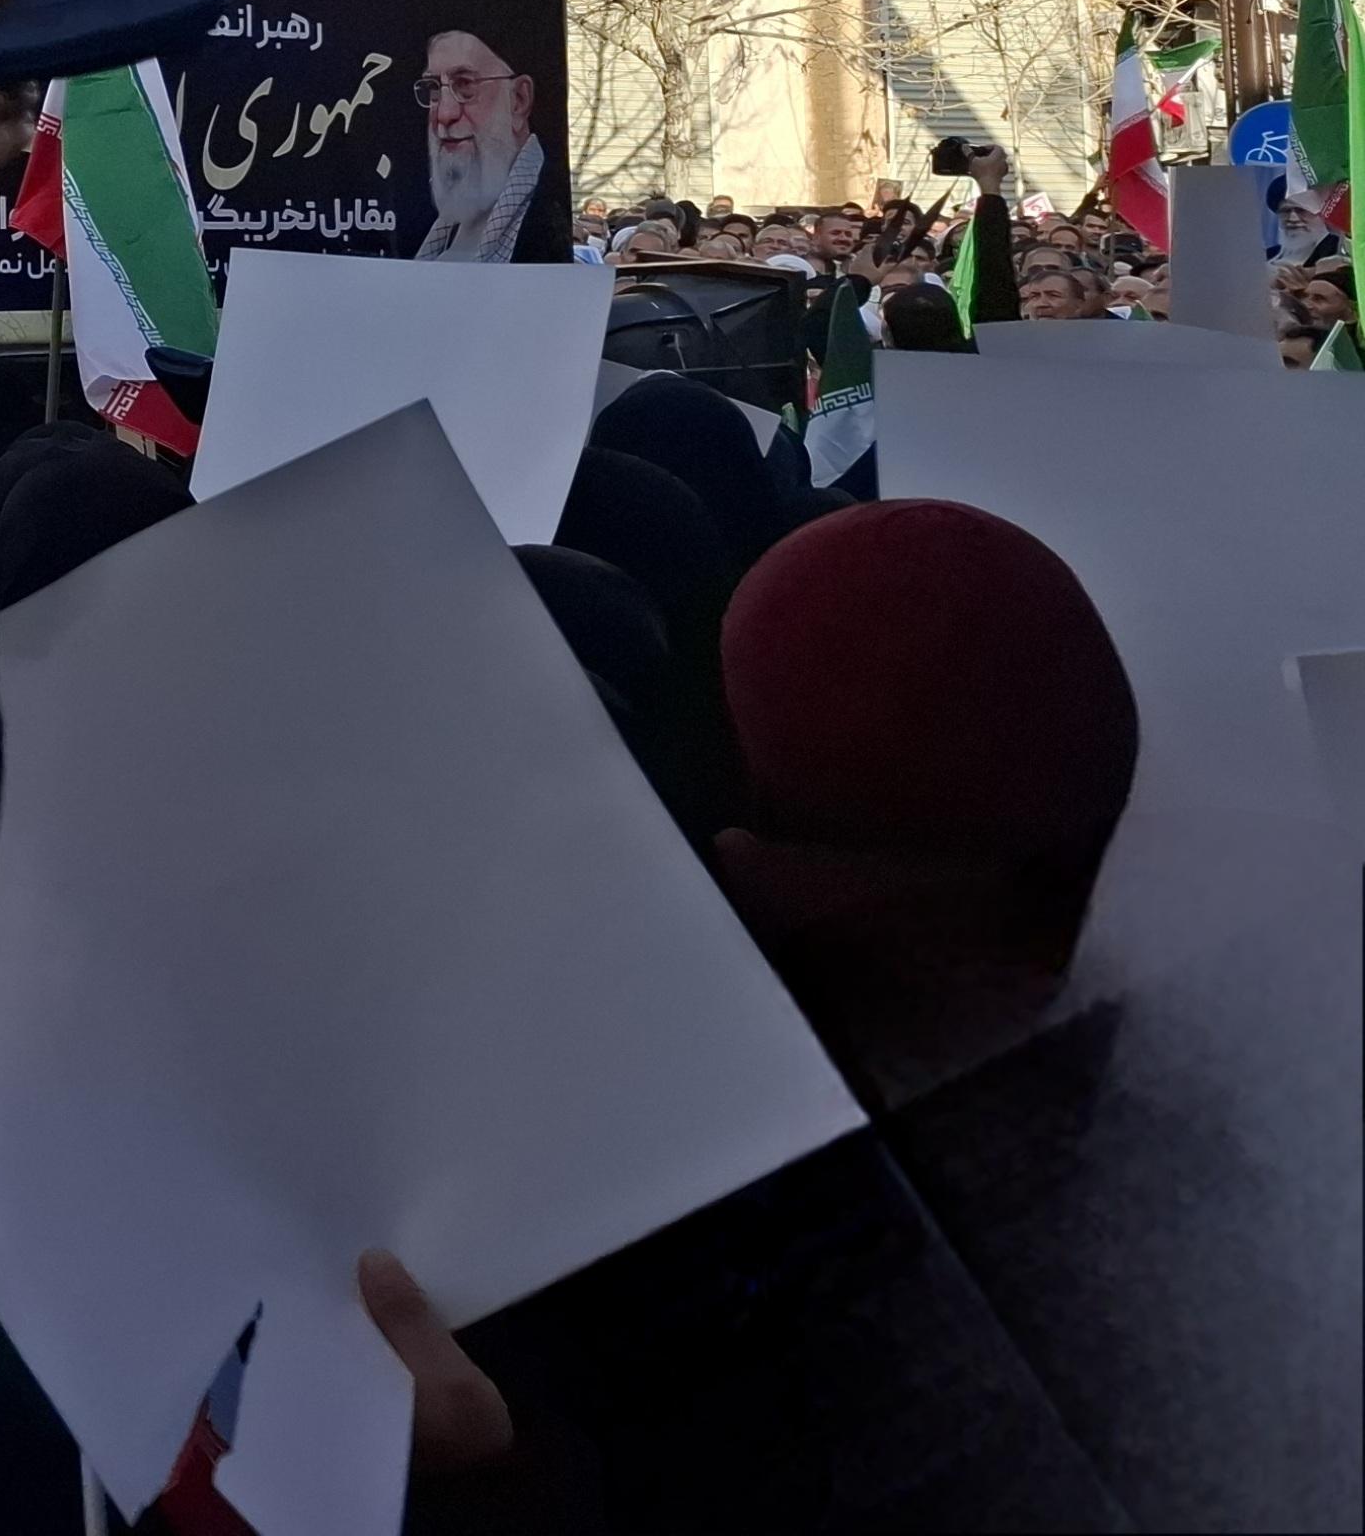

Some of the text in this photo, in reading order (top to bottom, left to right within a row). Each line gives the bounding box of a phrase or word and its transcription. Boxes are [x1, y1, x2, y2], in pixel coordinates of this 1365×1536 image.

[255, 12, 323, 51] رهبر
[202, 52, 393, 191] جمهوری
[319, 198, 397, 242] مقابل
